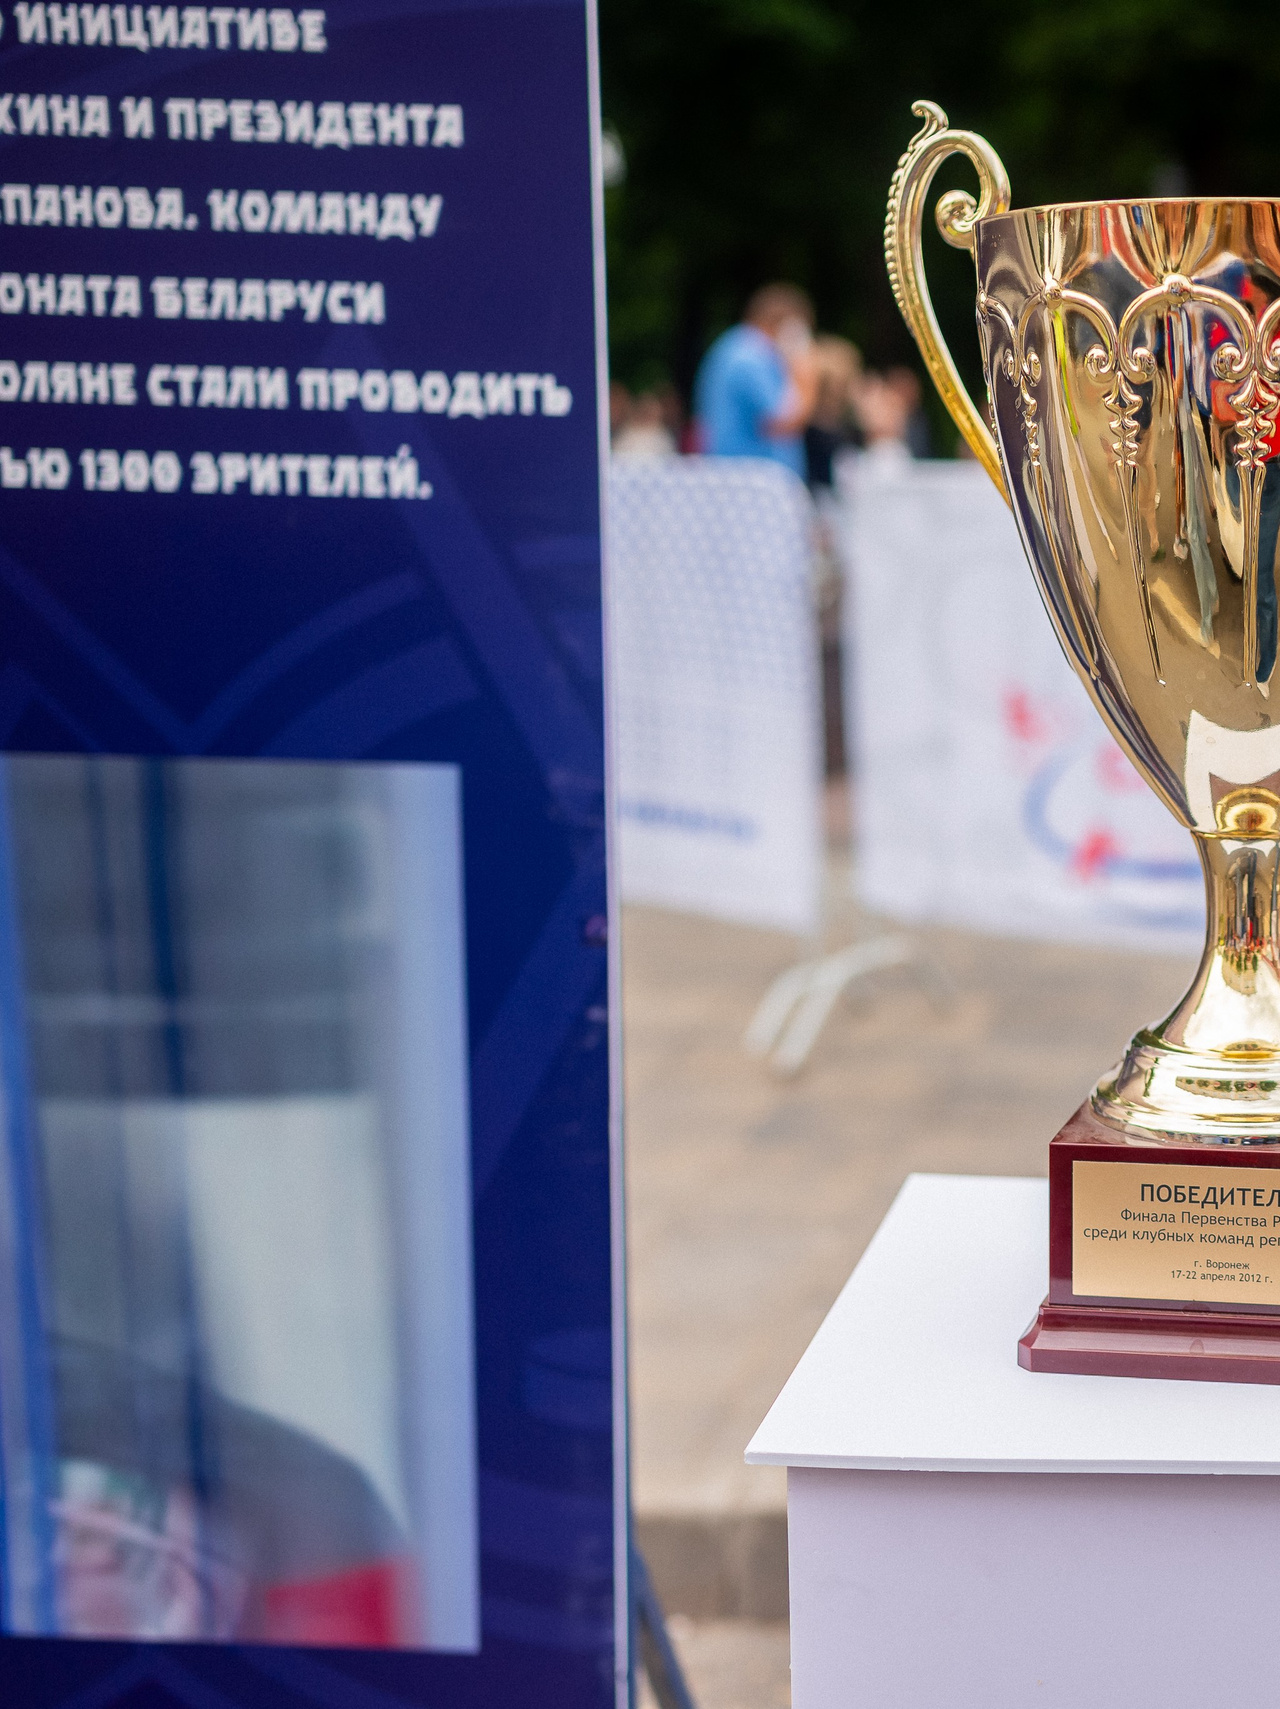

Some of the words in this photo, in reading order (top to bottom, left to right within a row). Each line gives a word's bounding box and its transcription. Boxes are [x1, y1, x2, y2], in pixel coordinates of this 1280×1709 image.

[14, 2, 327, 52] ИНИЦИАТИВЕ
[120, 97, 154, 138] И
[164, 98, 464, 149] ПРЕЗИДЕНТА
[207, 189, 442, 241] КОМАНДУ
[0, 273, 141, 317] ОНАТА
[151, 277, 385, 324] БЕЛАРУСИ
[0, 361, 137, 405] ОЛЯНЕ
[147, 364, 289, 409] СТАЛИ
[297, 368, 572, 419] ПРОВОДИТЬ
[0, 447, 70, 489] ЬЮ
[80, 449, 182, 492] 1300
[191, 444, 433, 499] ЗРИТЕЛЕЙ.
[1083, 1227, 1127, 1241] среди
[1132, 1228, 1195, 1243] клубных
[1199, 1233, 1254, 1248] команд
[1120, 1208, 1176, 1223] Финала
[1181, 1211, 1267, 1227] Первенства
[1171, 1269, 1197, 1280] 17-22
[1200, 1272, 1236, 1282] апреля
[1238, 1272, 1262, 1283] 2012
[1264, 1275, 1273, 1284] г.
[1193, 1259, 1202, 1268] г.
[1206, 1259, 1250, 1271] Воронеж
